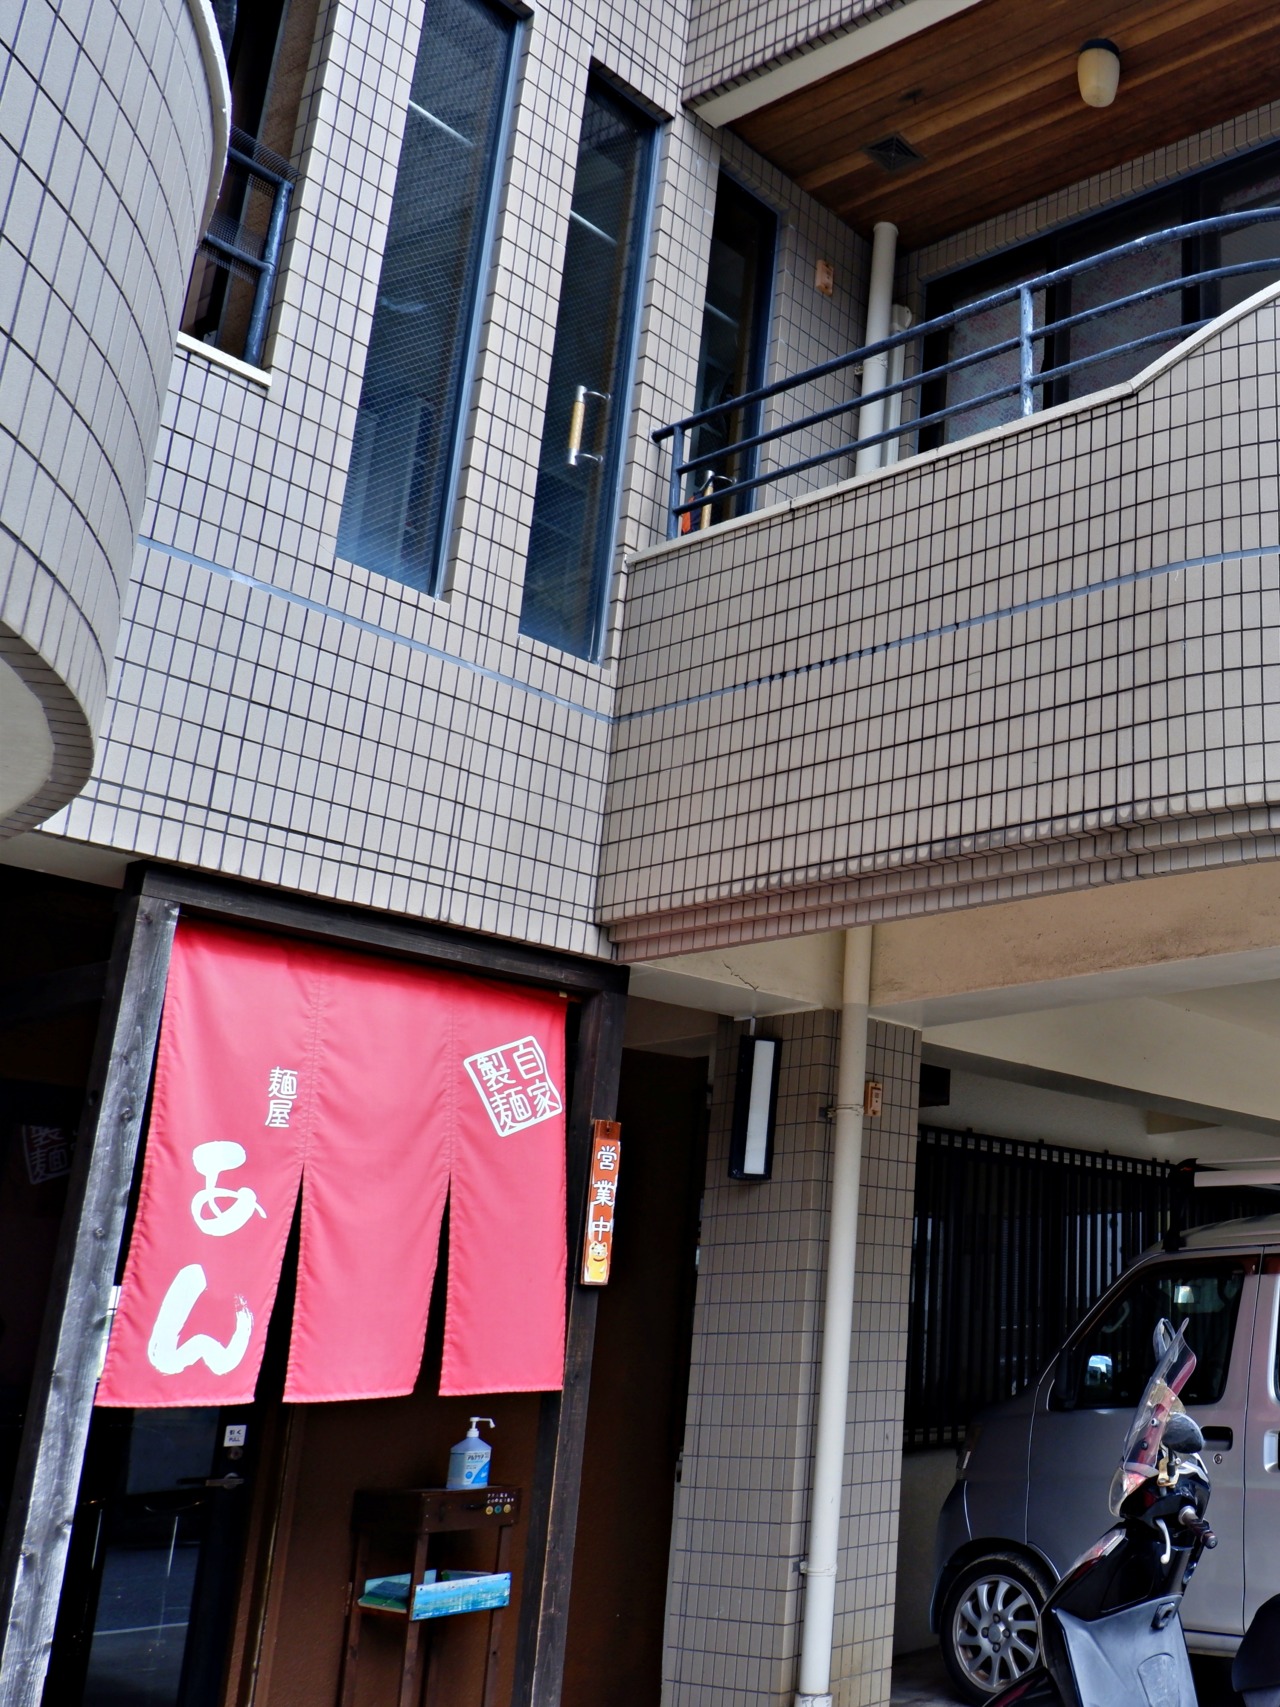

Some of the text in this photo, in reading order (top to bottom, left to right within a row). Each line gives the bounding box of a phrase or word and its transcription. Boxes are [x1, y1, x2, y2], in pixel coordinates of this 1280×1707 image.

[264, 1065, 299, 1128] 麺屋
[592, 1144, 618, 1242] 営業中
[147, 1140, 268, 1376] あん
